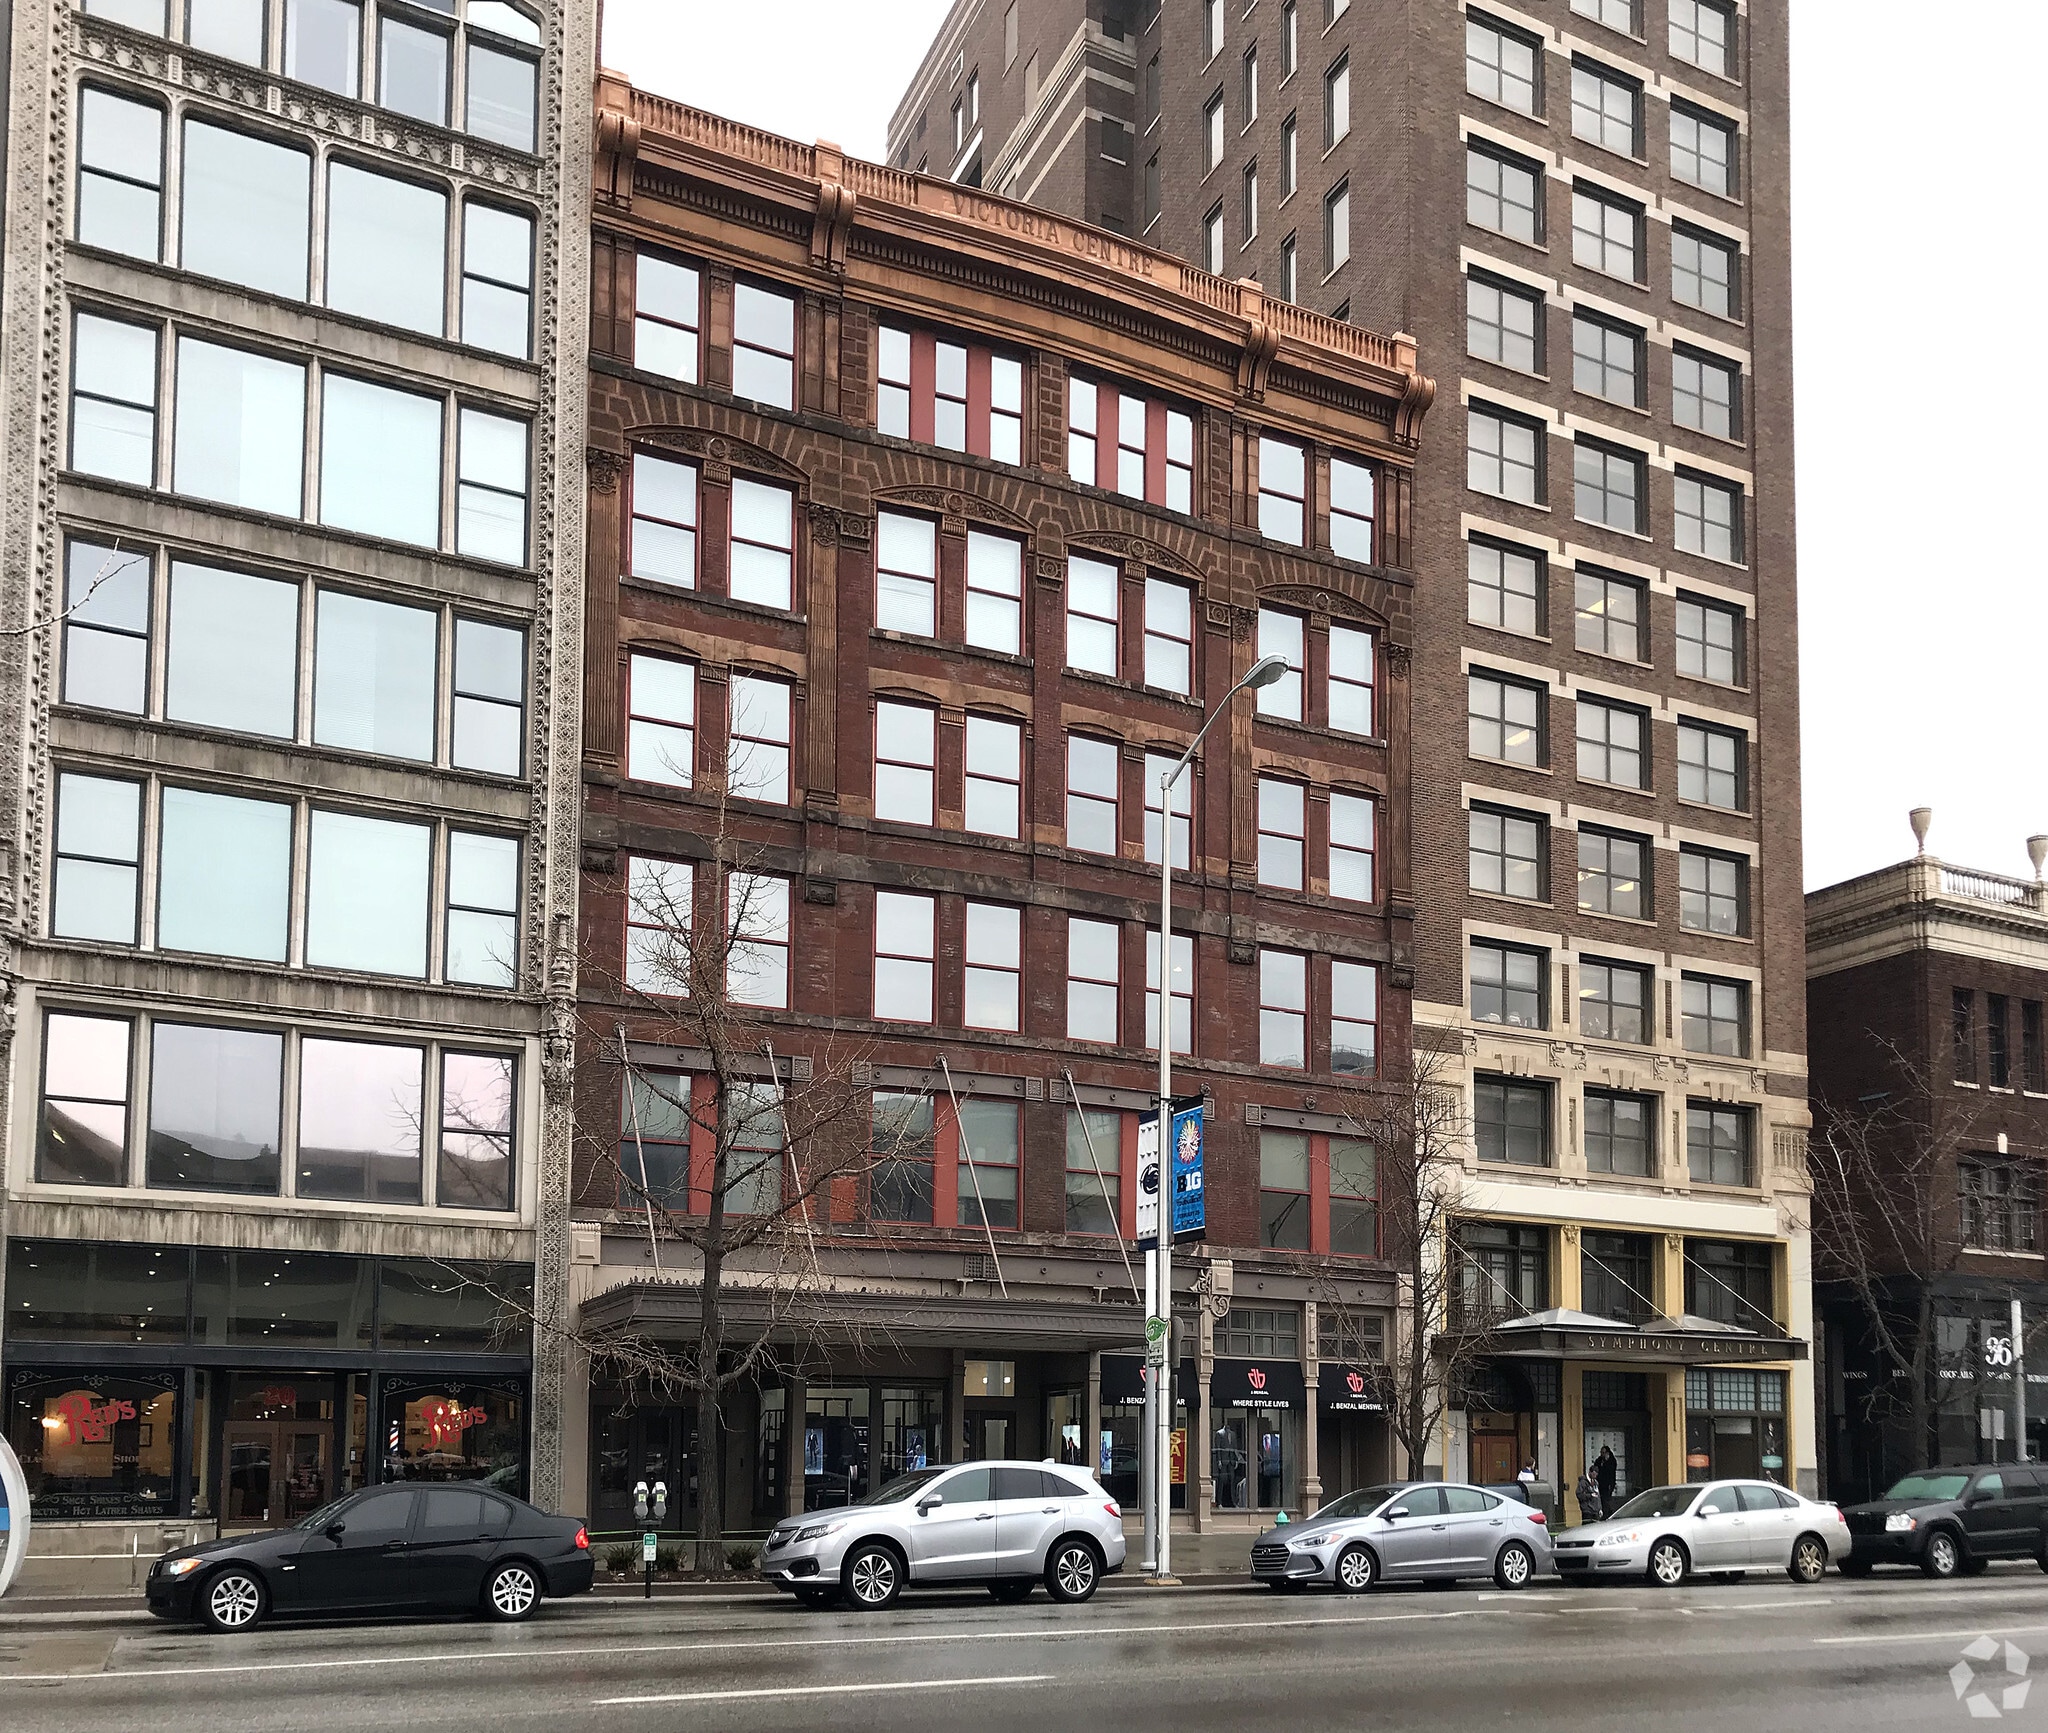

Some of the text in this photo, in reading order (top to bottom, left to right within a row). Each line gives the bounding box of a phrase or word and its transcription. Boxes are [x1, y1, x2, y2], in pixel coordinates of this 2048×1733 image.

[952, 191, 1154, 275] VICTORIA CENTRE
[1587, 1335, 1769, 1355] SYMPHONY CENTRE
[1985, 1336, 2013, 1366] 36
[1842, 1371, 1868, 1380] WINGS
[263, 1385, 296, 1406] 20
[1120, 1396, 1146, 1405] J. BENZA
[1232, 1399, 1254, 1407] WHERE
[1254, 1400, 1273, 1408] STYLE
[1170, 1432, 1182, 1482] SALE
[73, 1505, 91, 1515] HOT
[95, 1505, 127, 1515] LATHER
[131, 1504, 163, 1514] SHAVES
